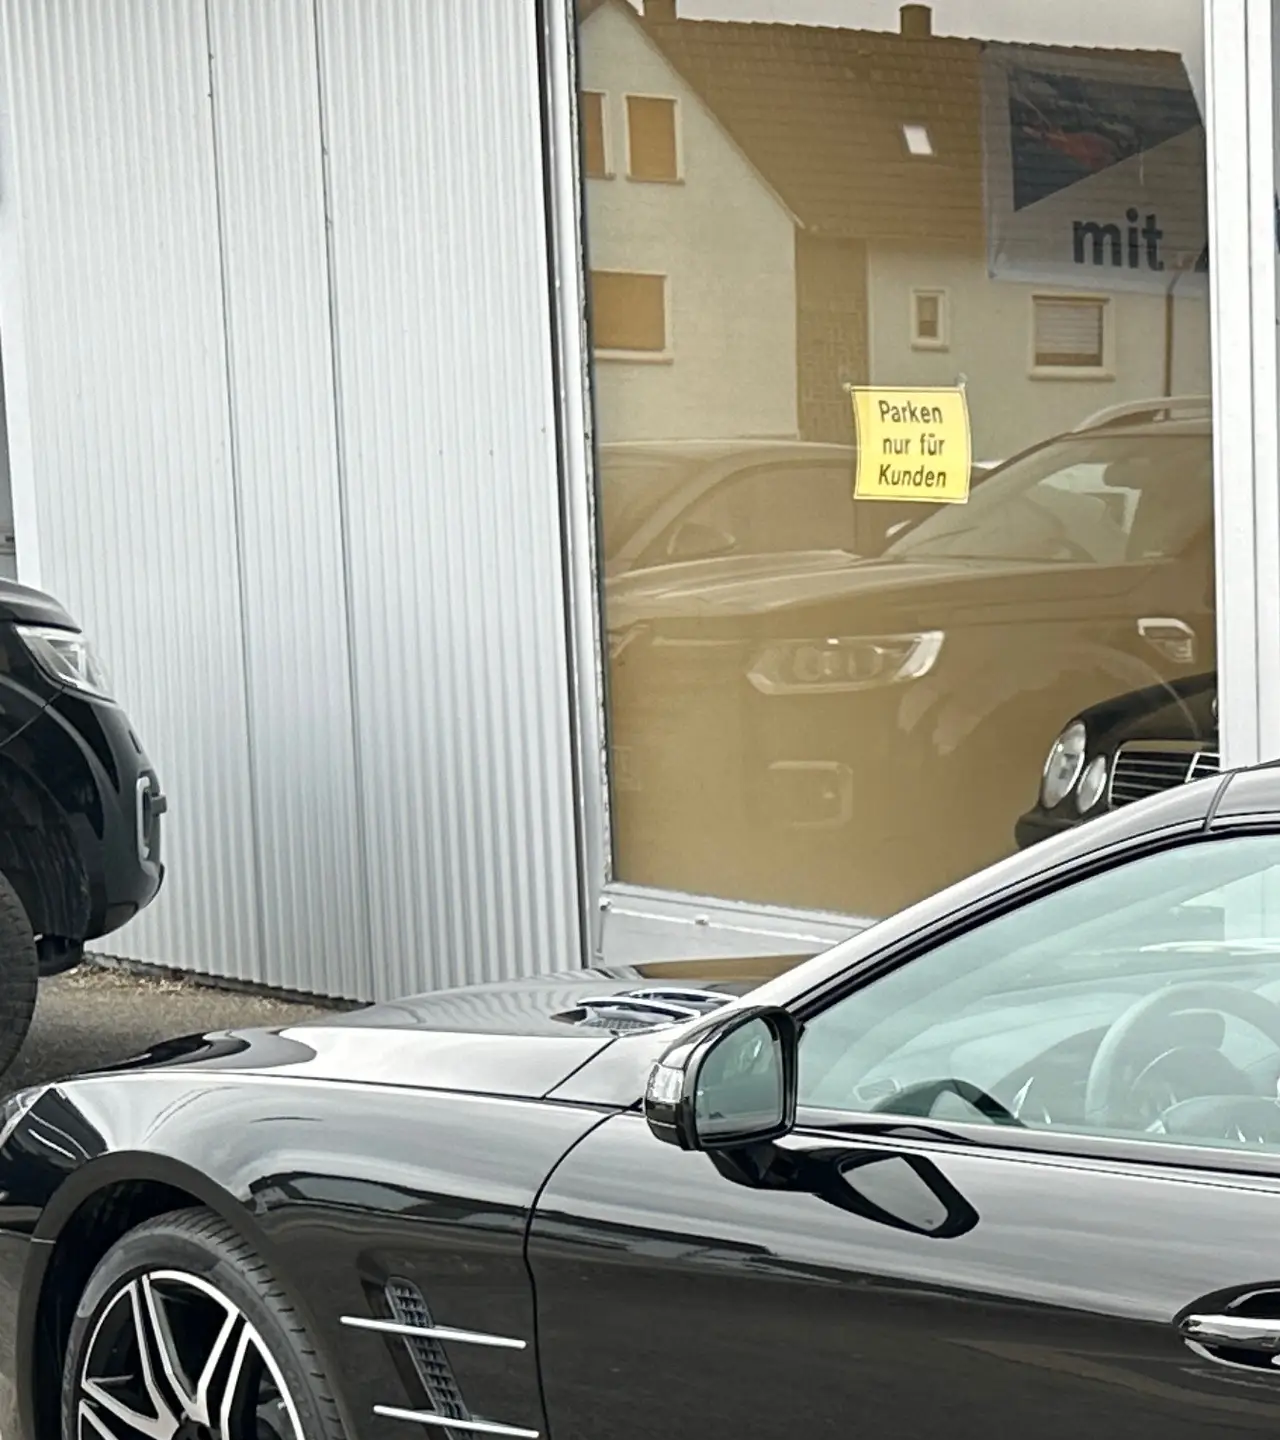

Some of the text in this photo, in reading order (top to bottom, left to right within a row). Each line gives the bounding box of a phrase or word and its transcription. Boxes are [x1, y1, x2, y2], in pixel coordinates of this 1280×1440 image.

[1073, 207, 1165, 271] mit
[878, 399, 943, 424] Parken
[883, 432, 945, 455] nur für
[877, 463, 946, 488] Kunden
